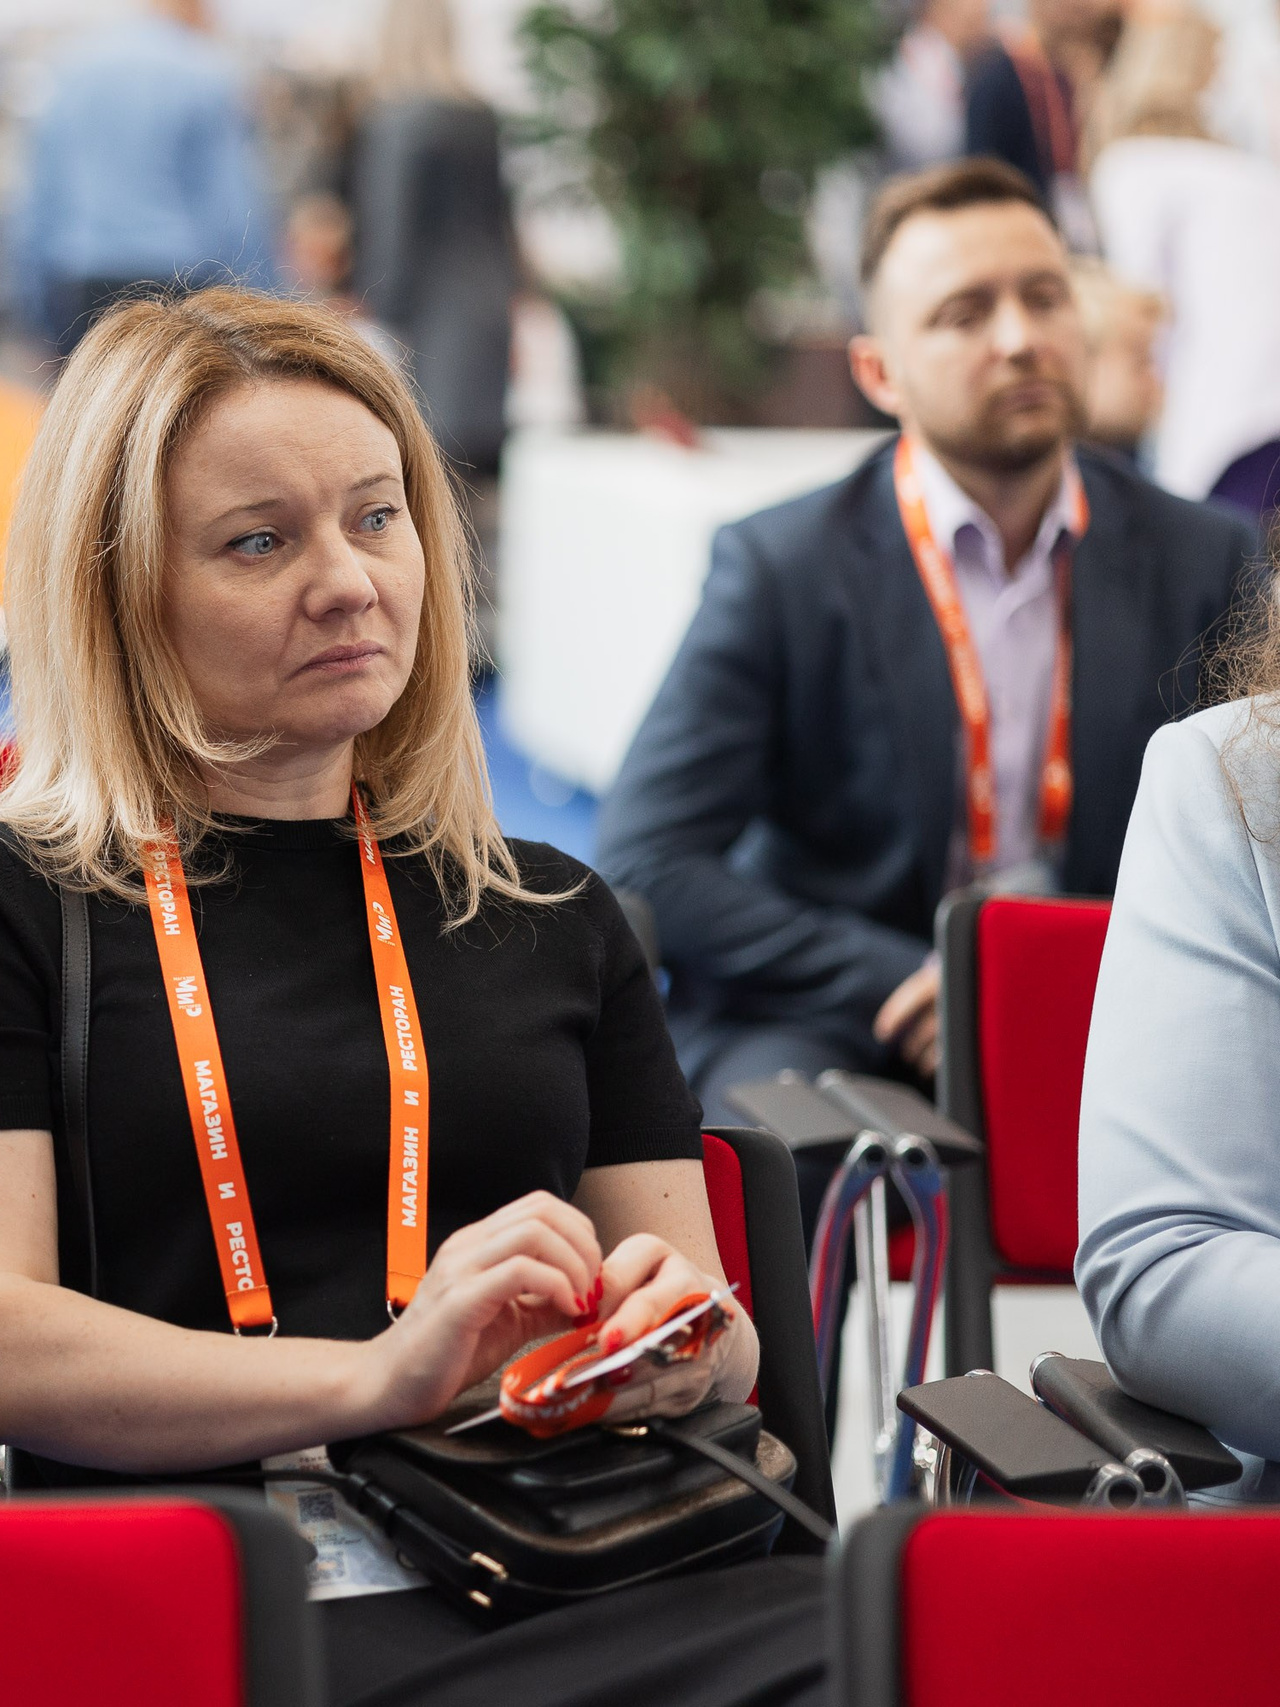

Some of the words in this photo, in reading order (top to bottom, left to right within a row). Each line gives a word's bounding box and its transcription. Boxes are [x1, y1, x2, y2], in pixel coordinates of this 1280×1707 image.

[150, 850, 181, 936] РЕСТОРАН
[388, 985, 418, 1072] РЕСТОРАН
[194, 1060, 228, 1160] МАГАЗИН
[218, 1182, 236, 1200] И
[403, 1090, 419, 1106] И
[401, 1126, 419, 1228] МАГАЗИН
